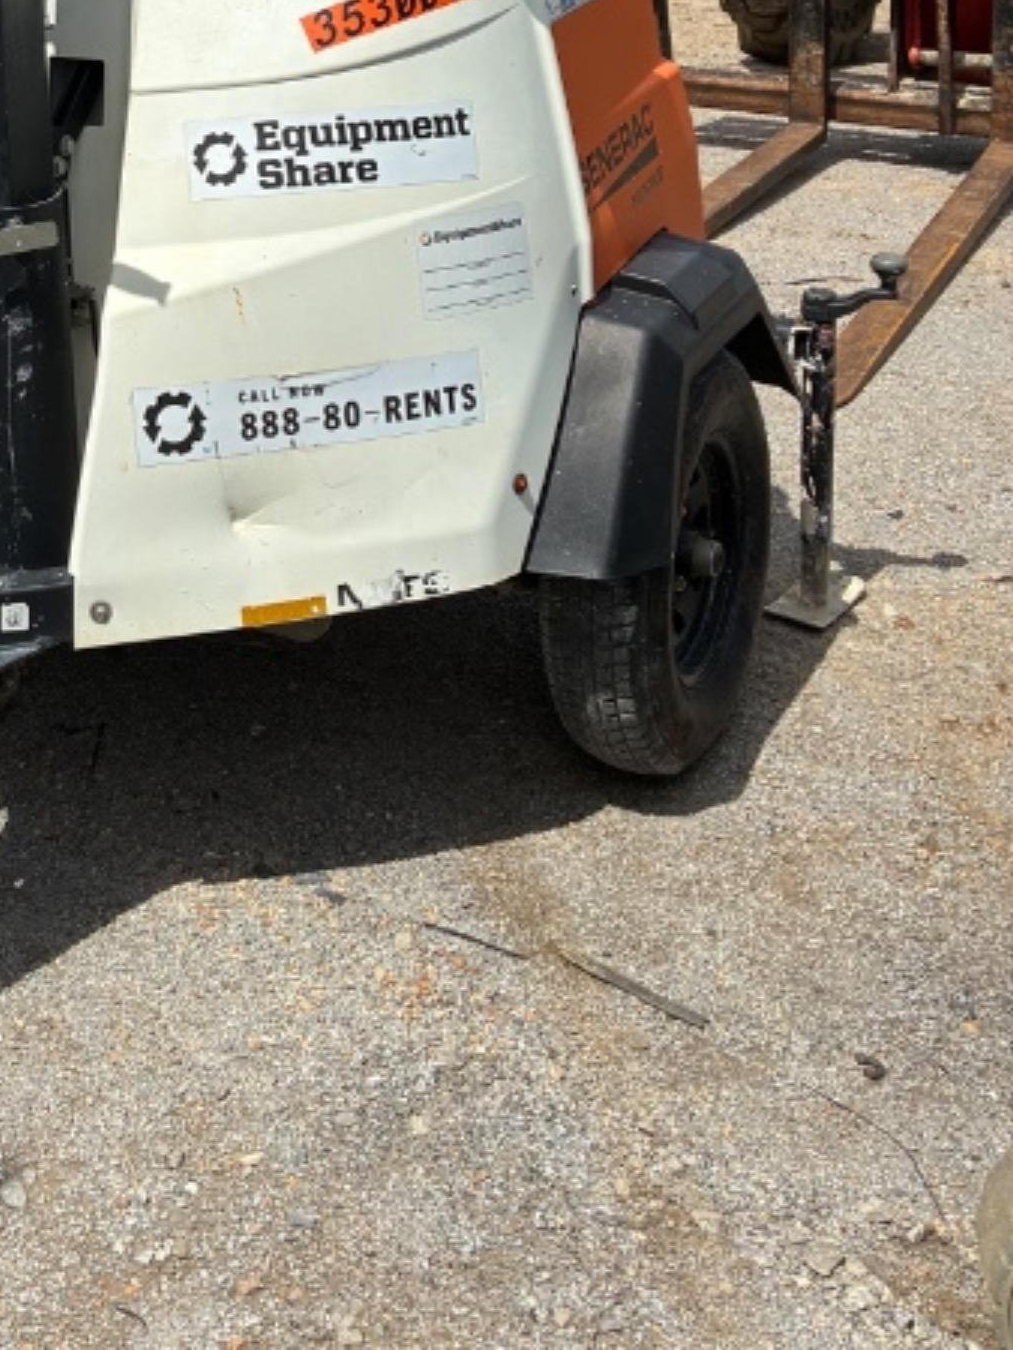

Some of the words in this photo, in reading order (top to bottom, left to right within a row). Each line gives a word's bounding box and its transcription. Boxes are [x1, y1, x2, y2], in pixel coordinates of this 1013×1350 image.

[253, 107, 471, 156] Equipment
[256, 156, 379, 189] Share
[238, 387, 280, 404] CALL
[289, 383, 326, 399] NOW
[240, 383, 477, 442] 888-80-RENTS
